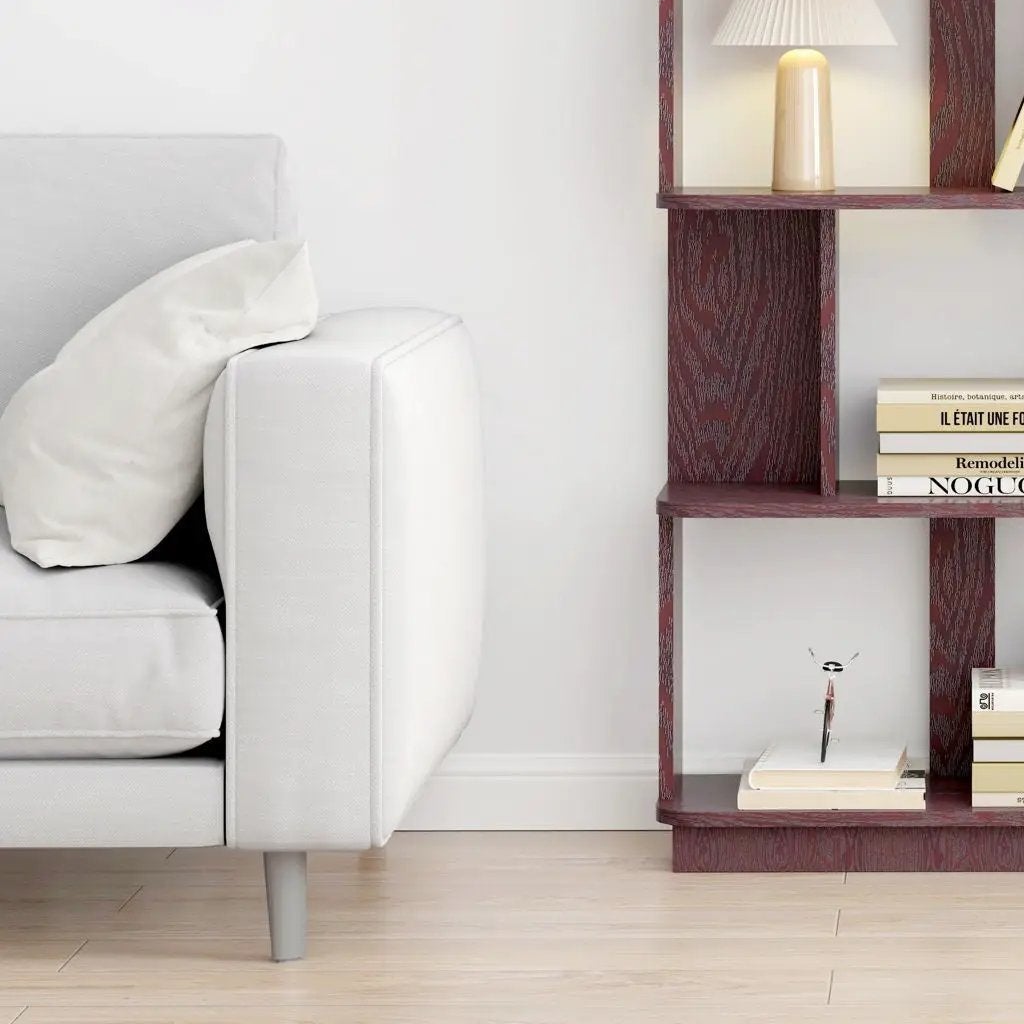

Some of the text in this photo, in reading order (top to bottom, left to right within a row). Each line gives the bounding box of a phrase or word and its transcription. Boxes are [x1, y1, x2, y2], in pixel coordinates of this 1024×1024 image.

[931, 393, 965, 401] Histoire,
[967, 393, 1006, 401] botanique,
[940, 411, 951, 426] IL
[953, 408, 985, 426] ÉTAIT
[987, 411, 1009, 426] UNE
